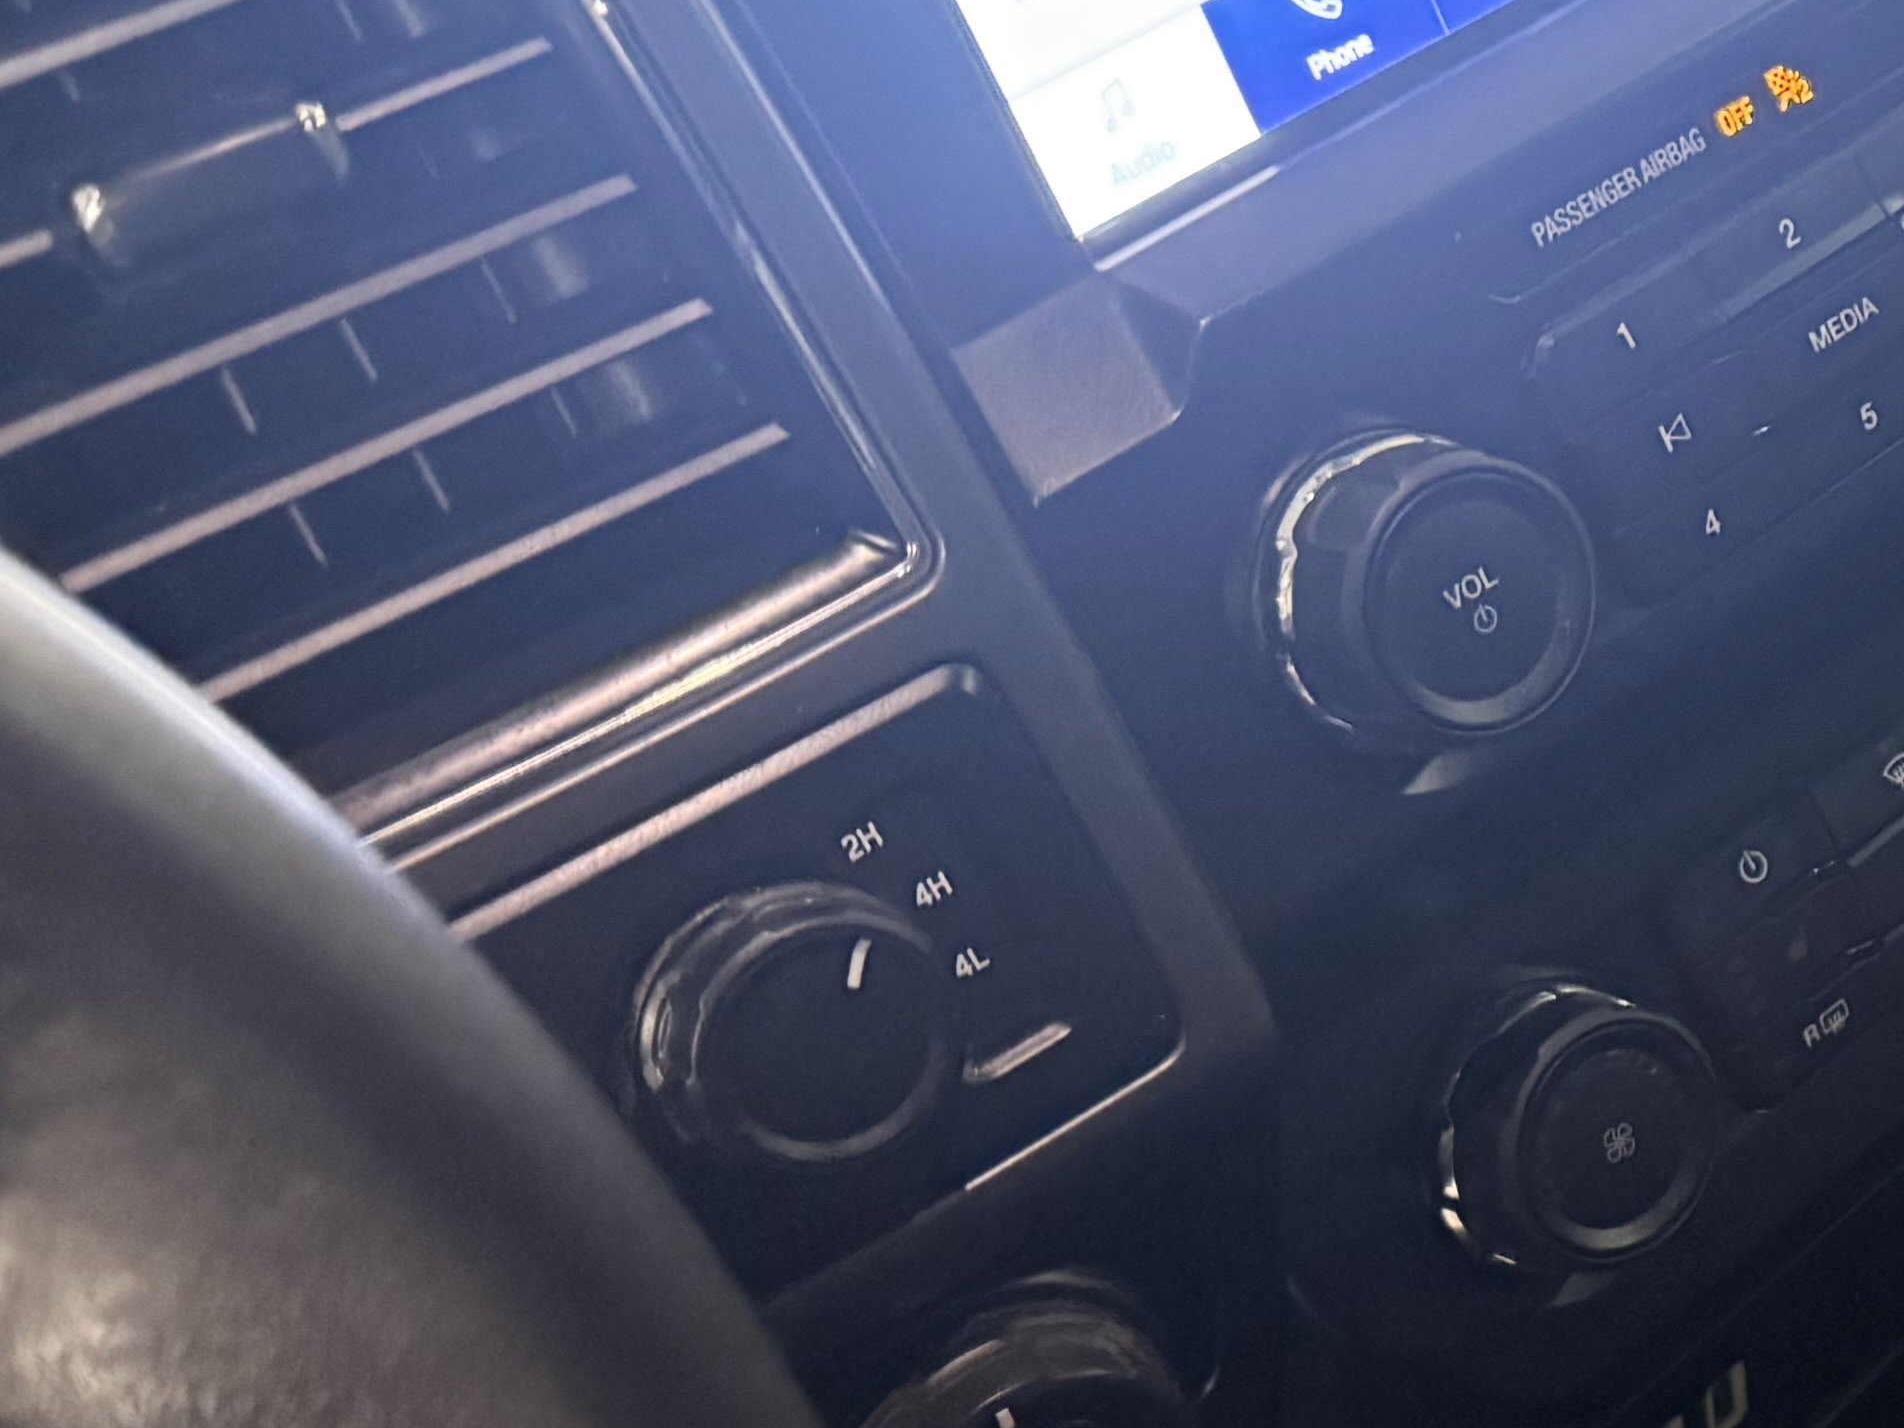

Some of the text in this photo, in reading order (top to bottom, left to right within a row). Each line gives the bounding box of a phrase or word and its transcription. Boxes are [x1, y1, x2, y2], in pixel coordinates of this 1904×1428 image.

[1305, 33, 1374, 80] Phone
[1109, 137, 1178, 190] Audio
[1531, 166, 1642, 248] PASSENGER
[1639, 127, 1707, 185] AIRBAG
[1714, 95, 1755, 138] OFF
[1778, 218, 1802, 249] 2
[1616, 321, 1638, 351] 1
[1807, 296, 1880, 354] MEDIA
[1859, 402, 1879, 432] 5
[1704, 508, 1722, 538] 4
[1442, 566, 1499, 610] VOL
[840, 821, 884, 863] 2H
[914, 870, 954, 910] 4H
[954, 946, 990, 980] 4L
